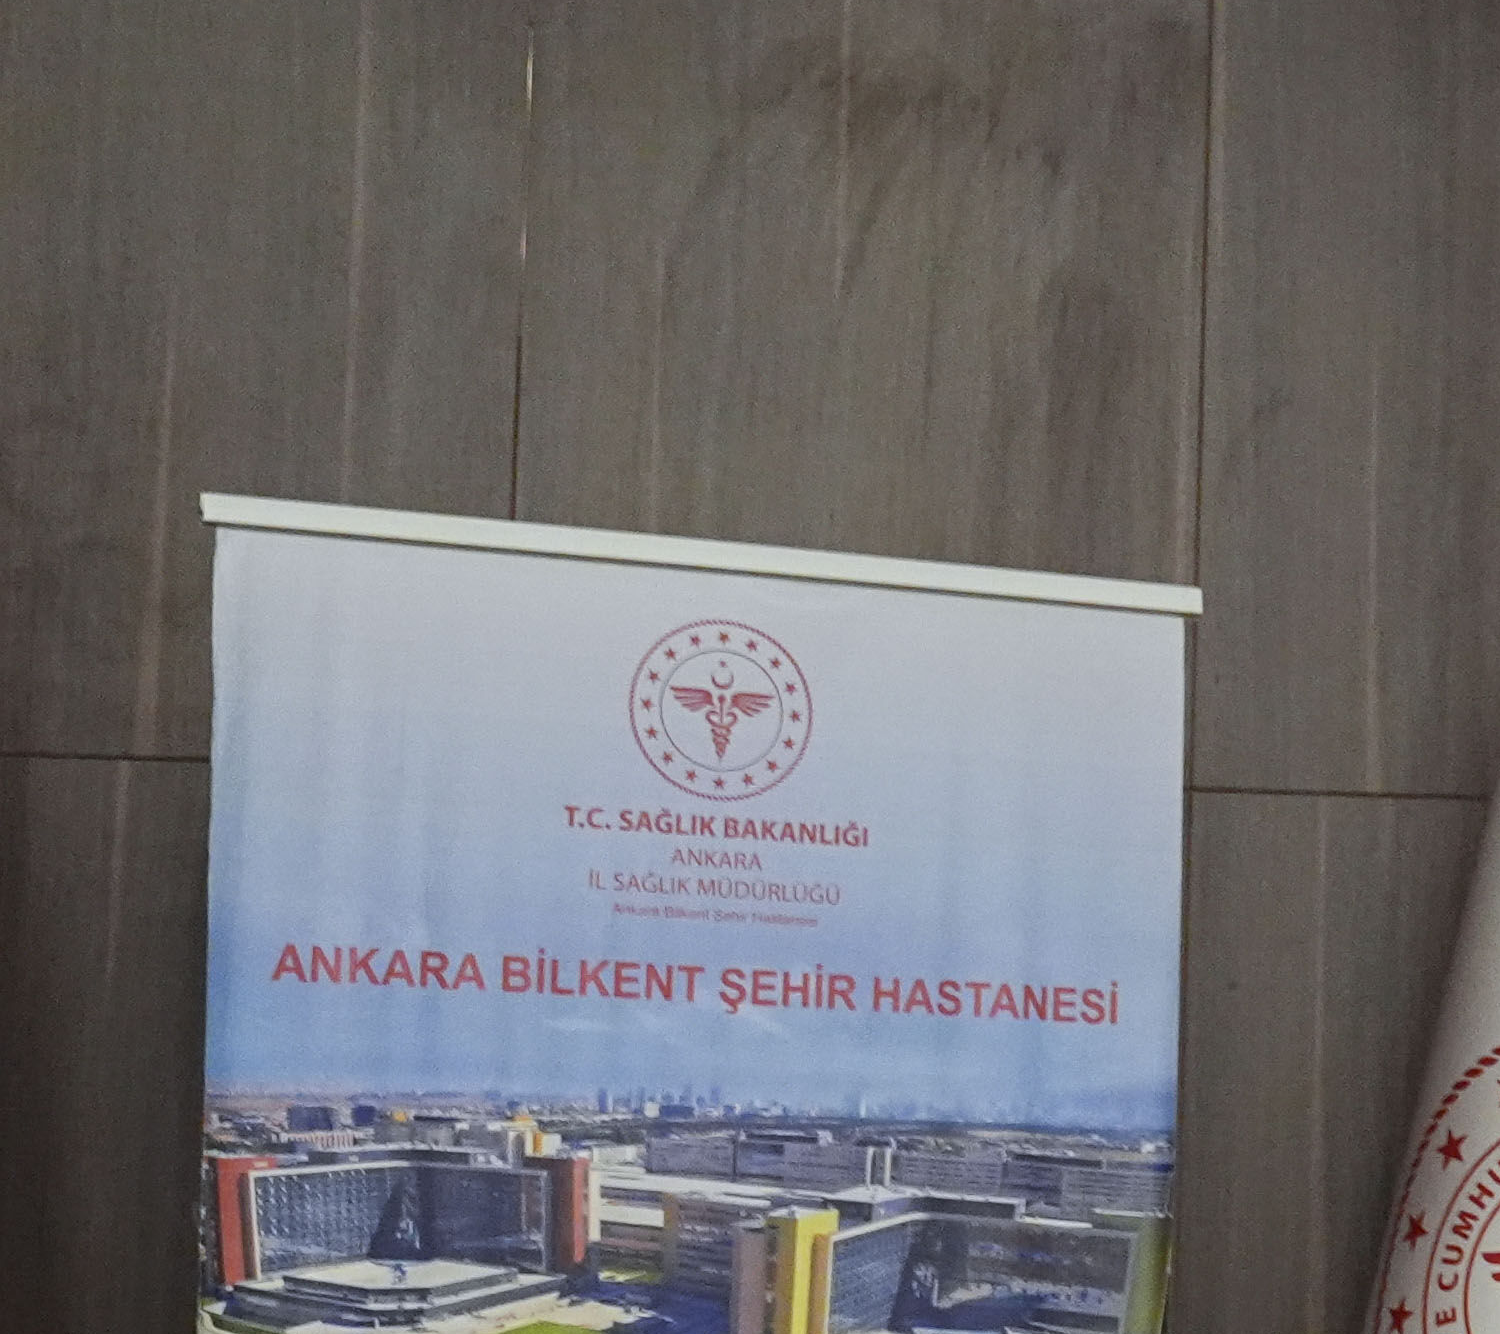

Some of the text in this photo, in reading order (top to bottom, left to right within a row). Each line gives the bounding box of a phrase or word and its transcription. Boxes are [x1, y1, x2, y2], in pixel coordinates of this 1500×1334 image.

[564, 804, 870, 848] T.C. SAĞLIK BAKANLIĞI
[671, 847, 764, 872] ANKARA
[612, 870, 691, 896] SAĞLIK
[696, 875, 842, 906] MÜDÜRLÜĞÜ
[271, 941, 1121, 1027] ANKARA BİLKENT ŞEHİR HASTANESİ
